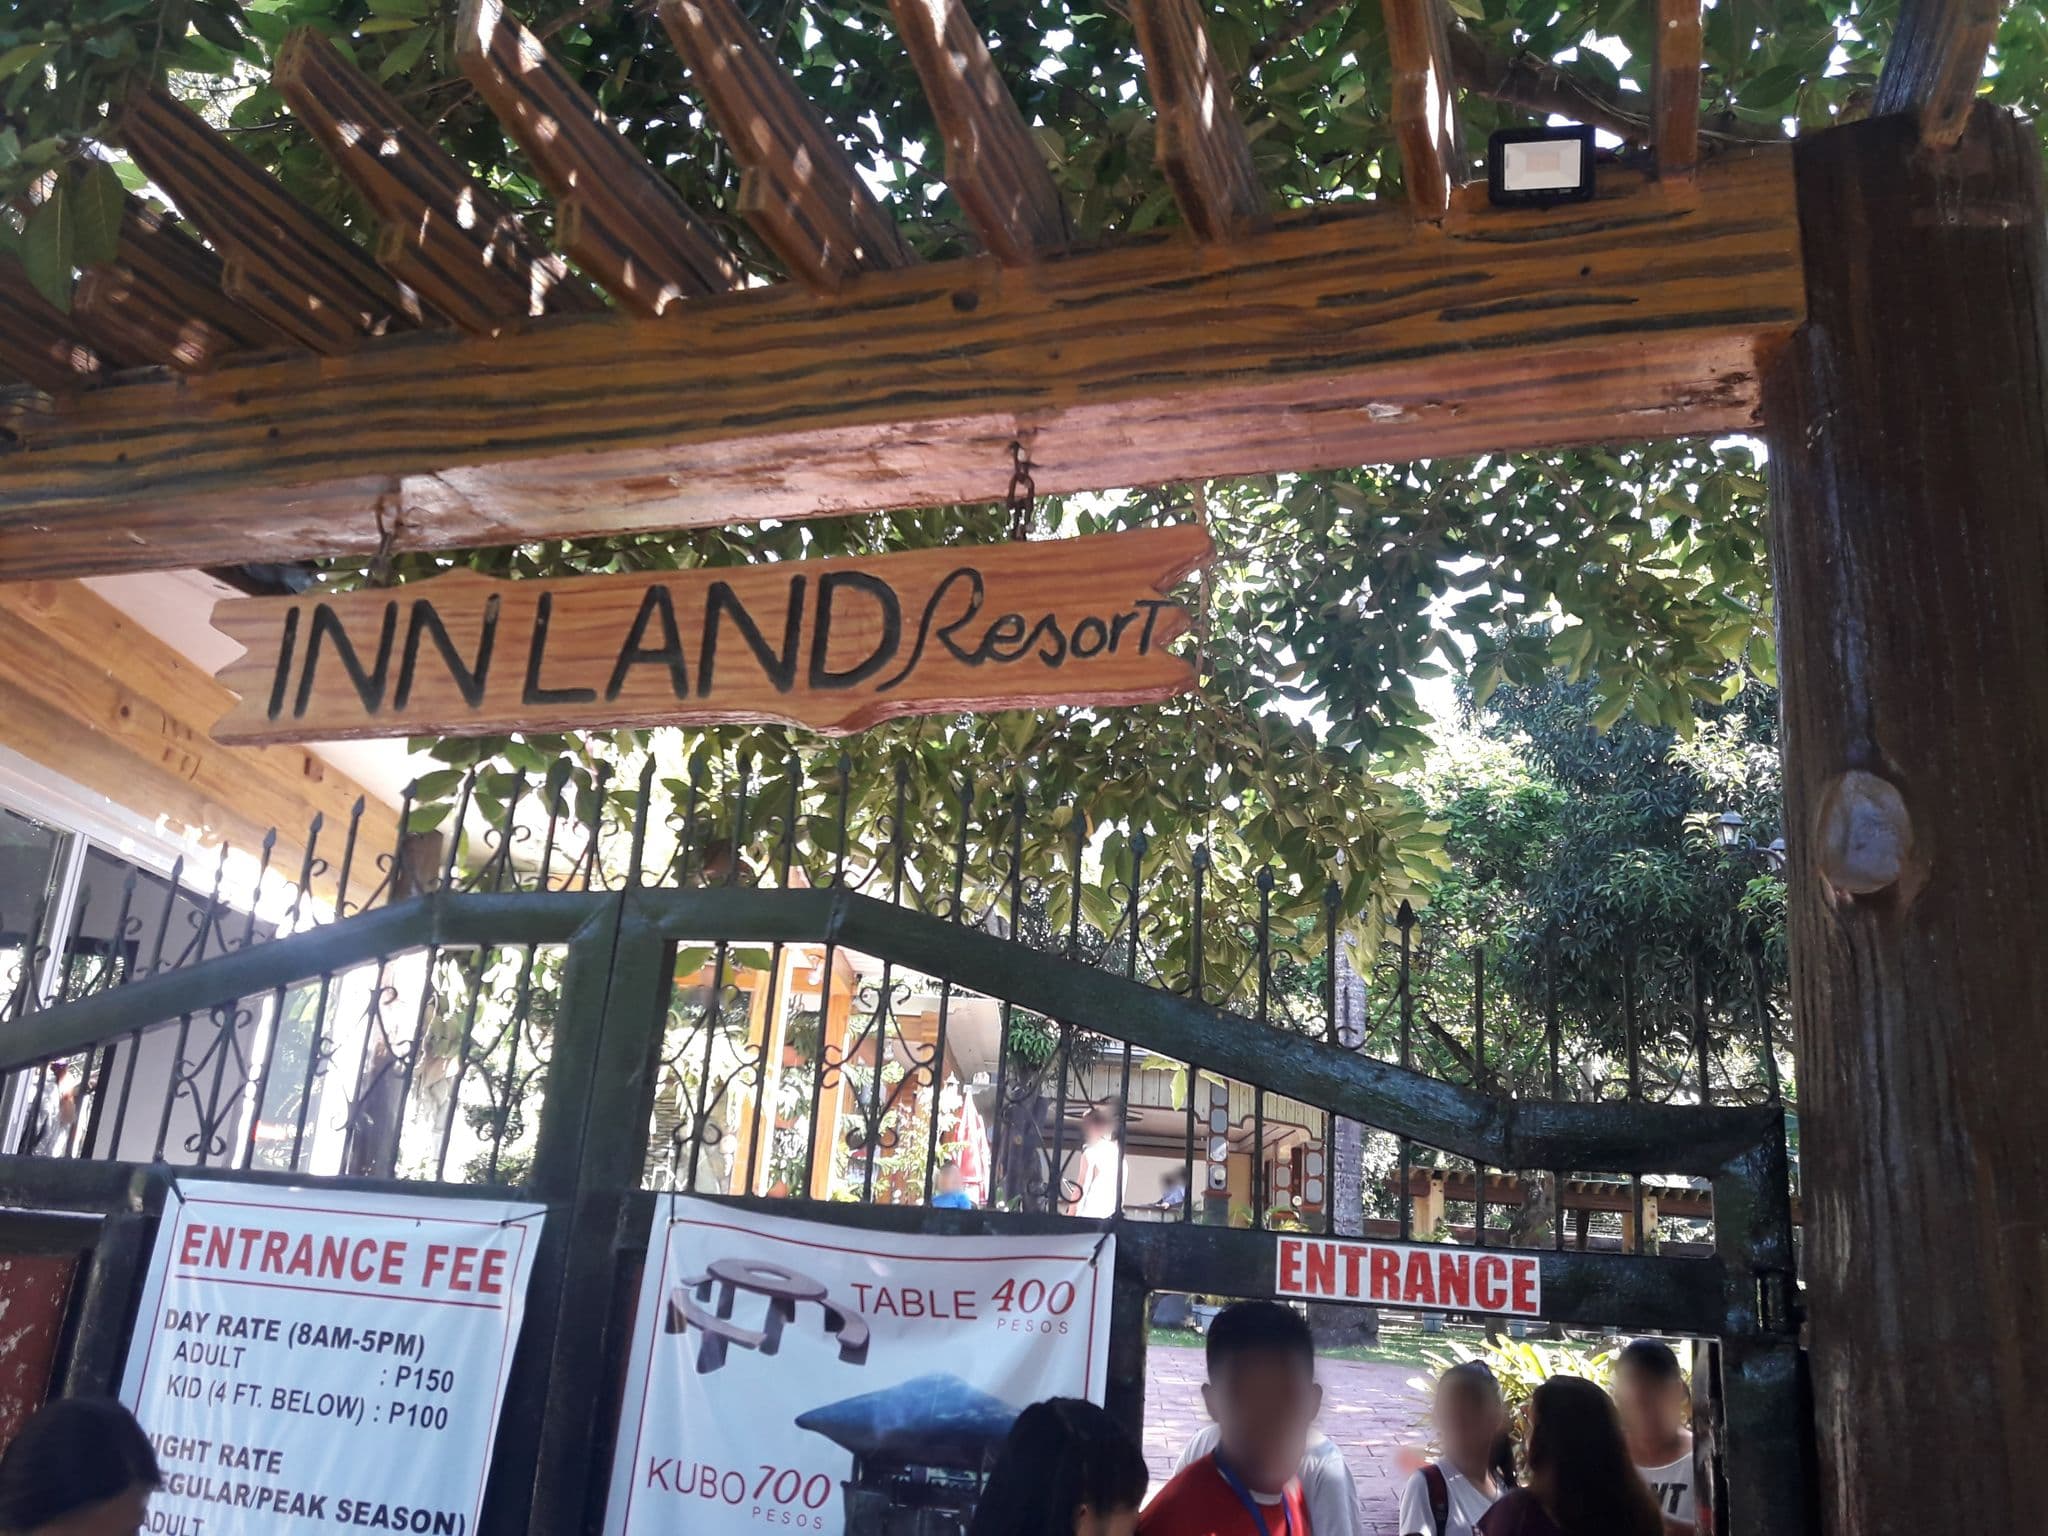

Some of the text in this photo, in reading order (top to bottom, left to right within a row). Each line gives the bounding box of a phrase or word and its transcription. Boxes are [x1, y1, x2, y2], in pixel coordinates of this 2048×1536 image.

[179, 1224, 508, 1294] ENTRANCE FEE
[1278, 1240, 1539, 1314] ENTRANCE
[851, 1278, 1076, 1320] TABLE 400
[164, 1308, 425, 1363] DAY RATE (8AM-5PM)
[996, 1318, 1070, 1335] PESOS
[173, 1341, 247, 1369] ADULT
[395, 1365, 455, 1393] P150
[166, 1374, 203, 1399] KID
[208, 1379, 227, 1407] (4
[233, 1383, 262, 1408] FT.
[270, 1388, 366, 1426] BELOW)
[389, 1402, 449, 1430] P100
[149, 1432, 283, 1474] IGHT RATE
[647, 1456, 831, 1510] KUBO 700
[335, 1498, 466, 1536] SEASON)
[752, 1506, 825, 1531] PESOS
